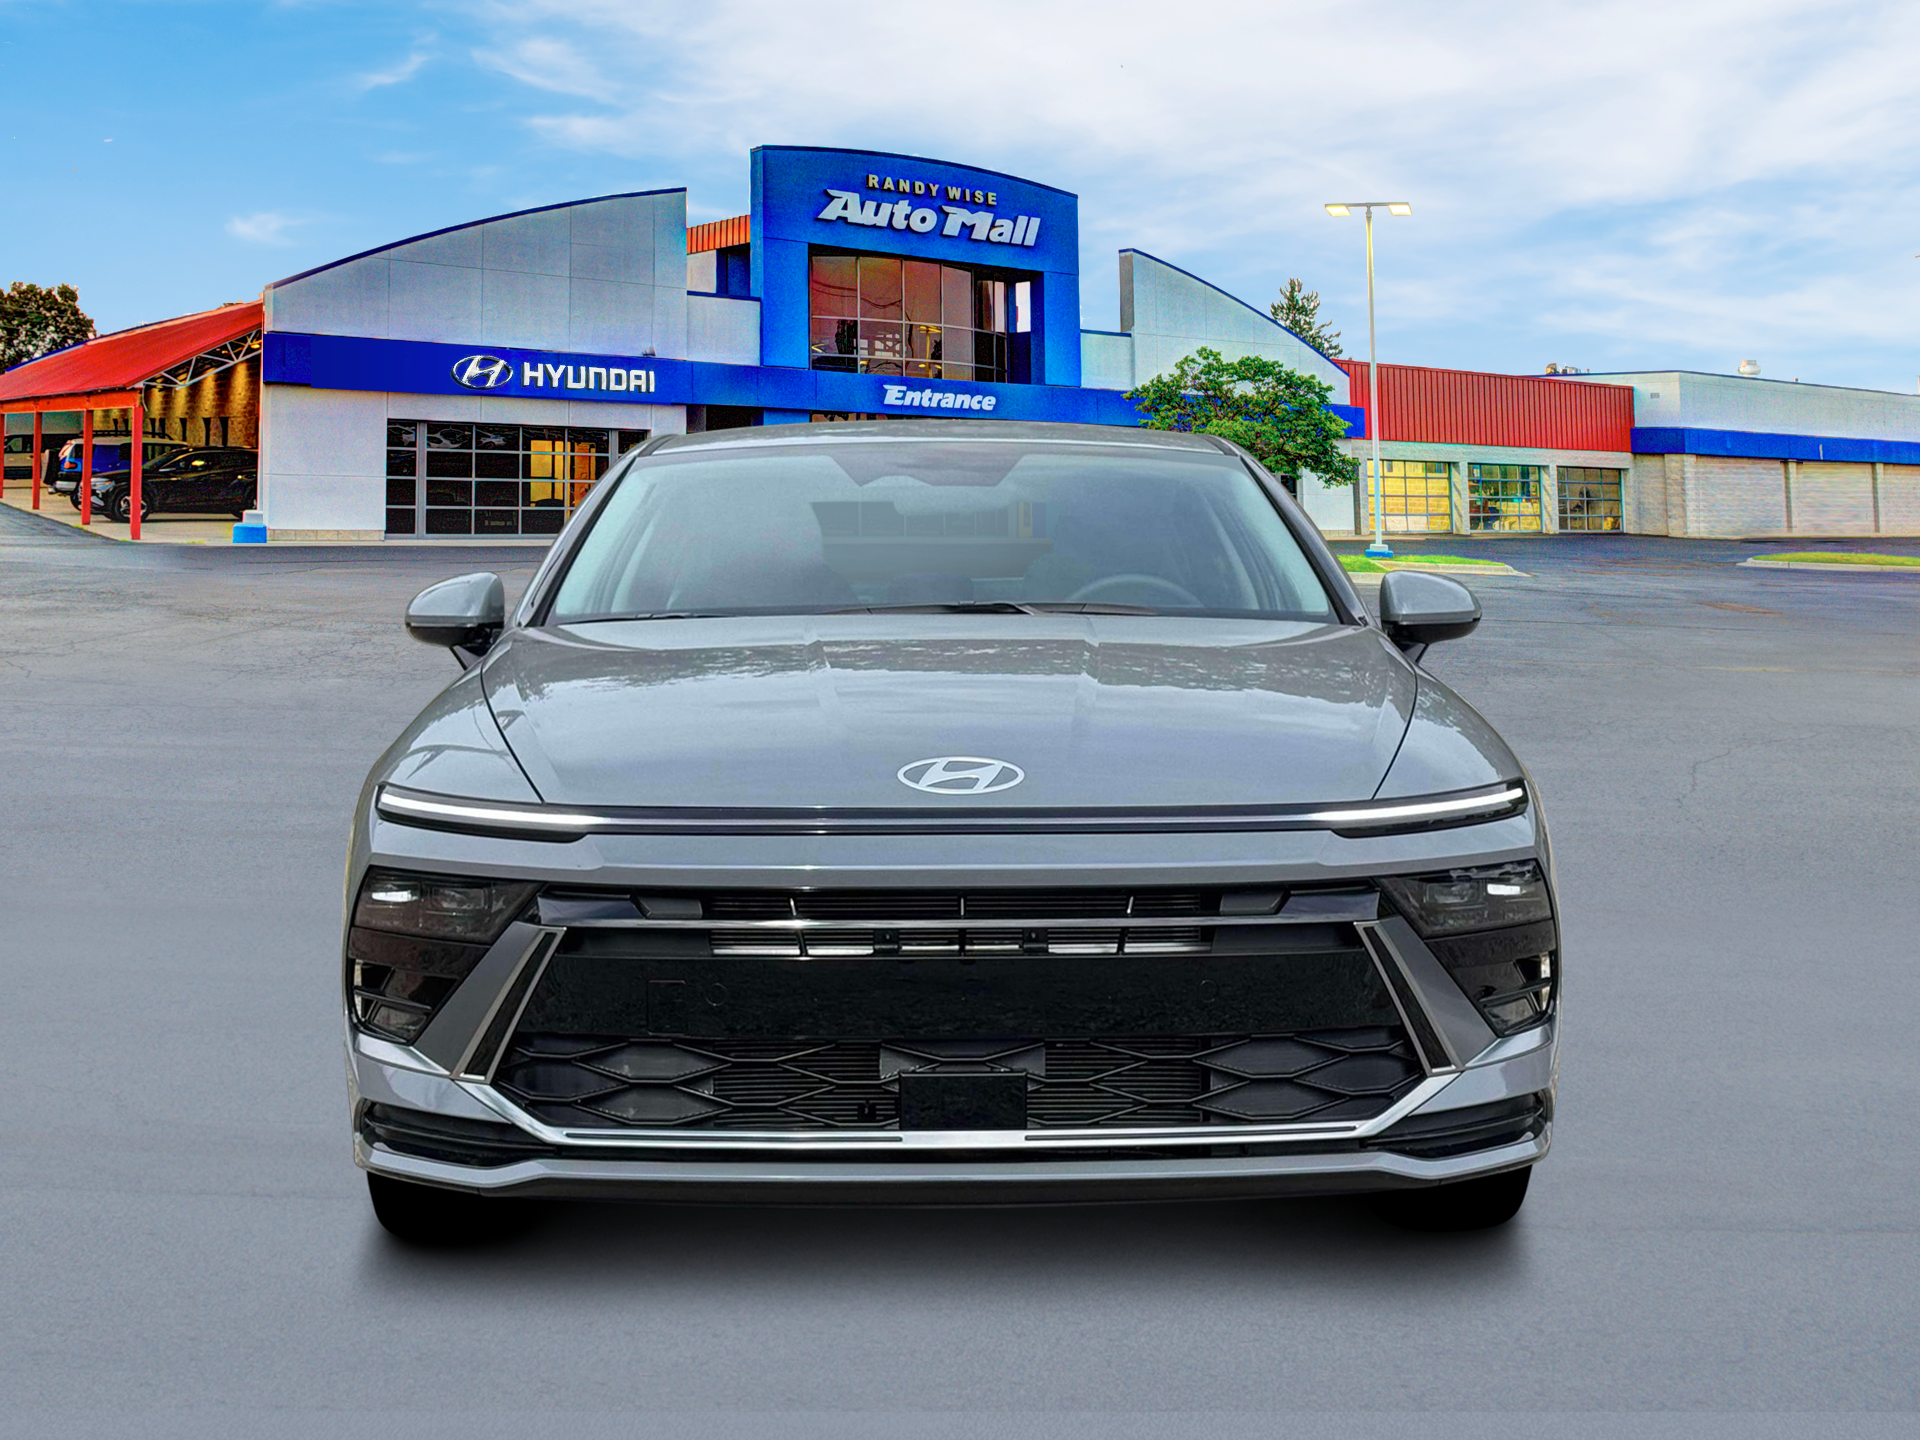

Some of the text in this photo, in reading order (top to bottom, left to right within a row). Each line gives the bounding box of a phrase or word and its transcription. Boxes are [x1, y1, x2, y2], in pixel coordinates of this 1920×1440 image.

[867, 174, 998, 206] RANDY WISE
[816, 188, 1041, 247] Auto Mall
[522, 361, 656, 393] HYUNDAI
[883, 384, 997, 411] Entrance
